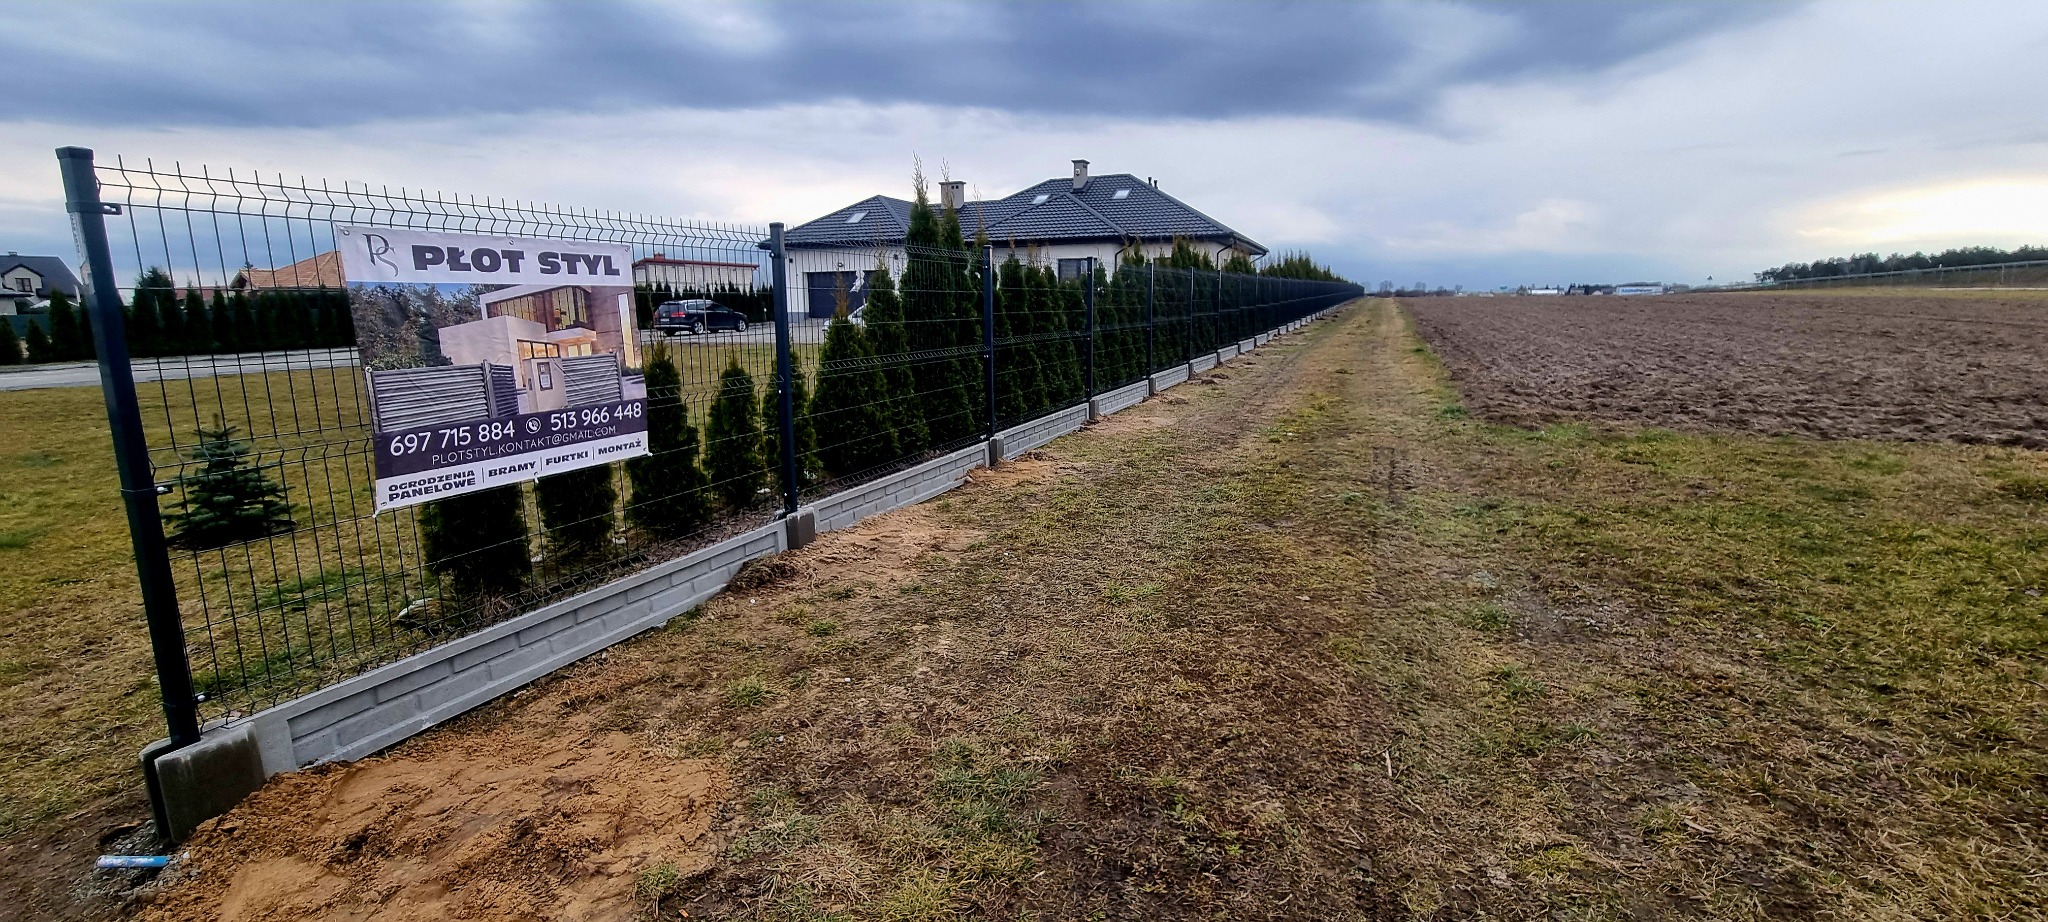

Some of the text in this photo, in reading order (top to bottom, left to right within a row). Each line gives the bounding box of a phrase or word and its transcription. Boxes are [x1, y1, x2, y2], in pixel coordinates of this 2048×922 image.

[411, 244, 621, 276] PŁOT STYL
[550, 402, 642, 431] 513 966 448
[390, 420, 516, 457] 697 715 884
[431, 425, 616, 465] PLOTSTYL.KONTAKT@GMAIL.COM
[597, 438, 642, 455] MONTAŻ
[488, 461, 536, 477] BRAMY
[545, 451, 589, 466] FURTKI
[388, 469, 475, 492] OGRODZENIA
[388, 477, 476, 502] PANELOWE
